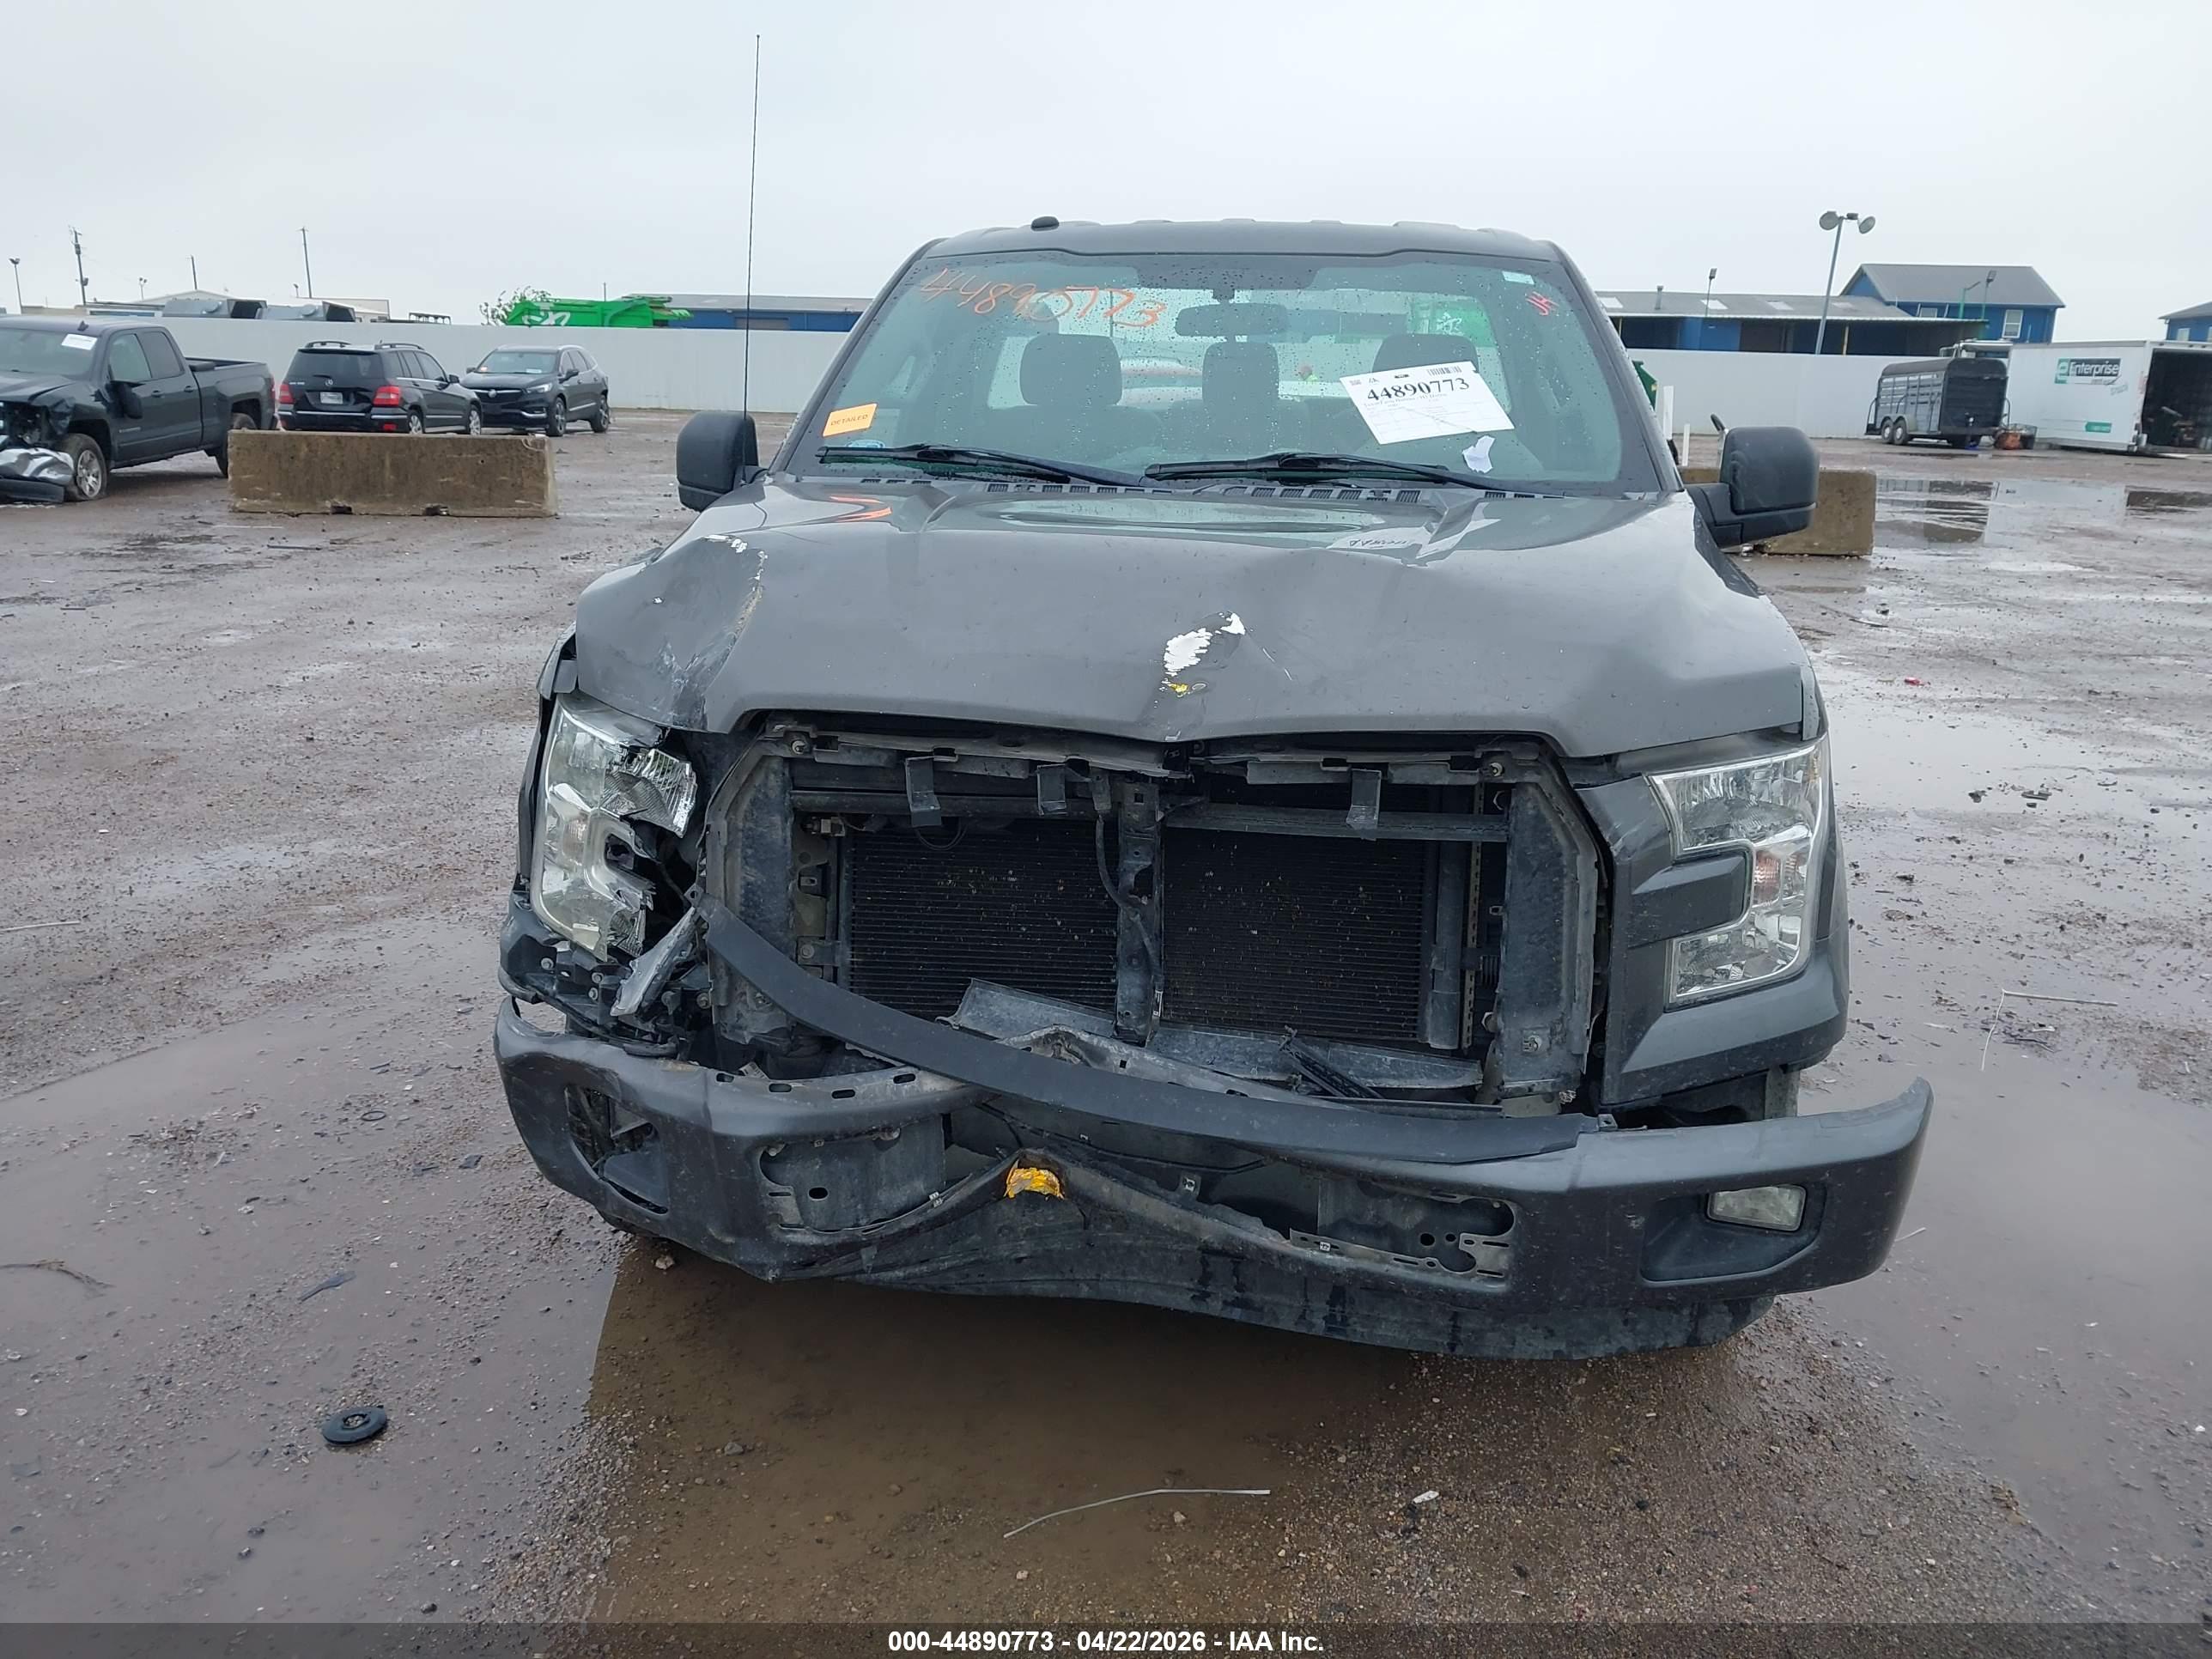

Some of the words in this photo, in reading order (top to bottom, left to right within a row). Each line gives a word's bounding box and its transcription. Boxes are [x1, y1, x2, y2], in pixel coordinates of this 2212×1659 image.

[921, 268, 1167, 328] 44890773
[2069, 360, 2119, 378] Enterprise
[1367, 377, 1470, 401] 44890773
